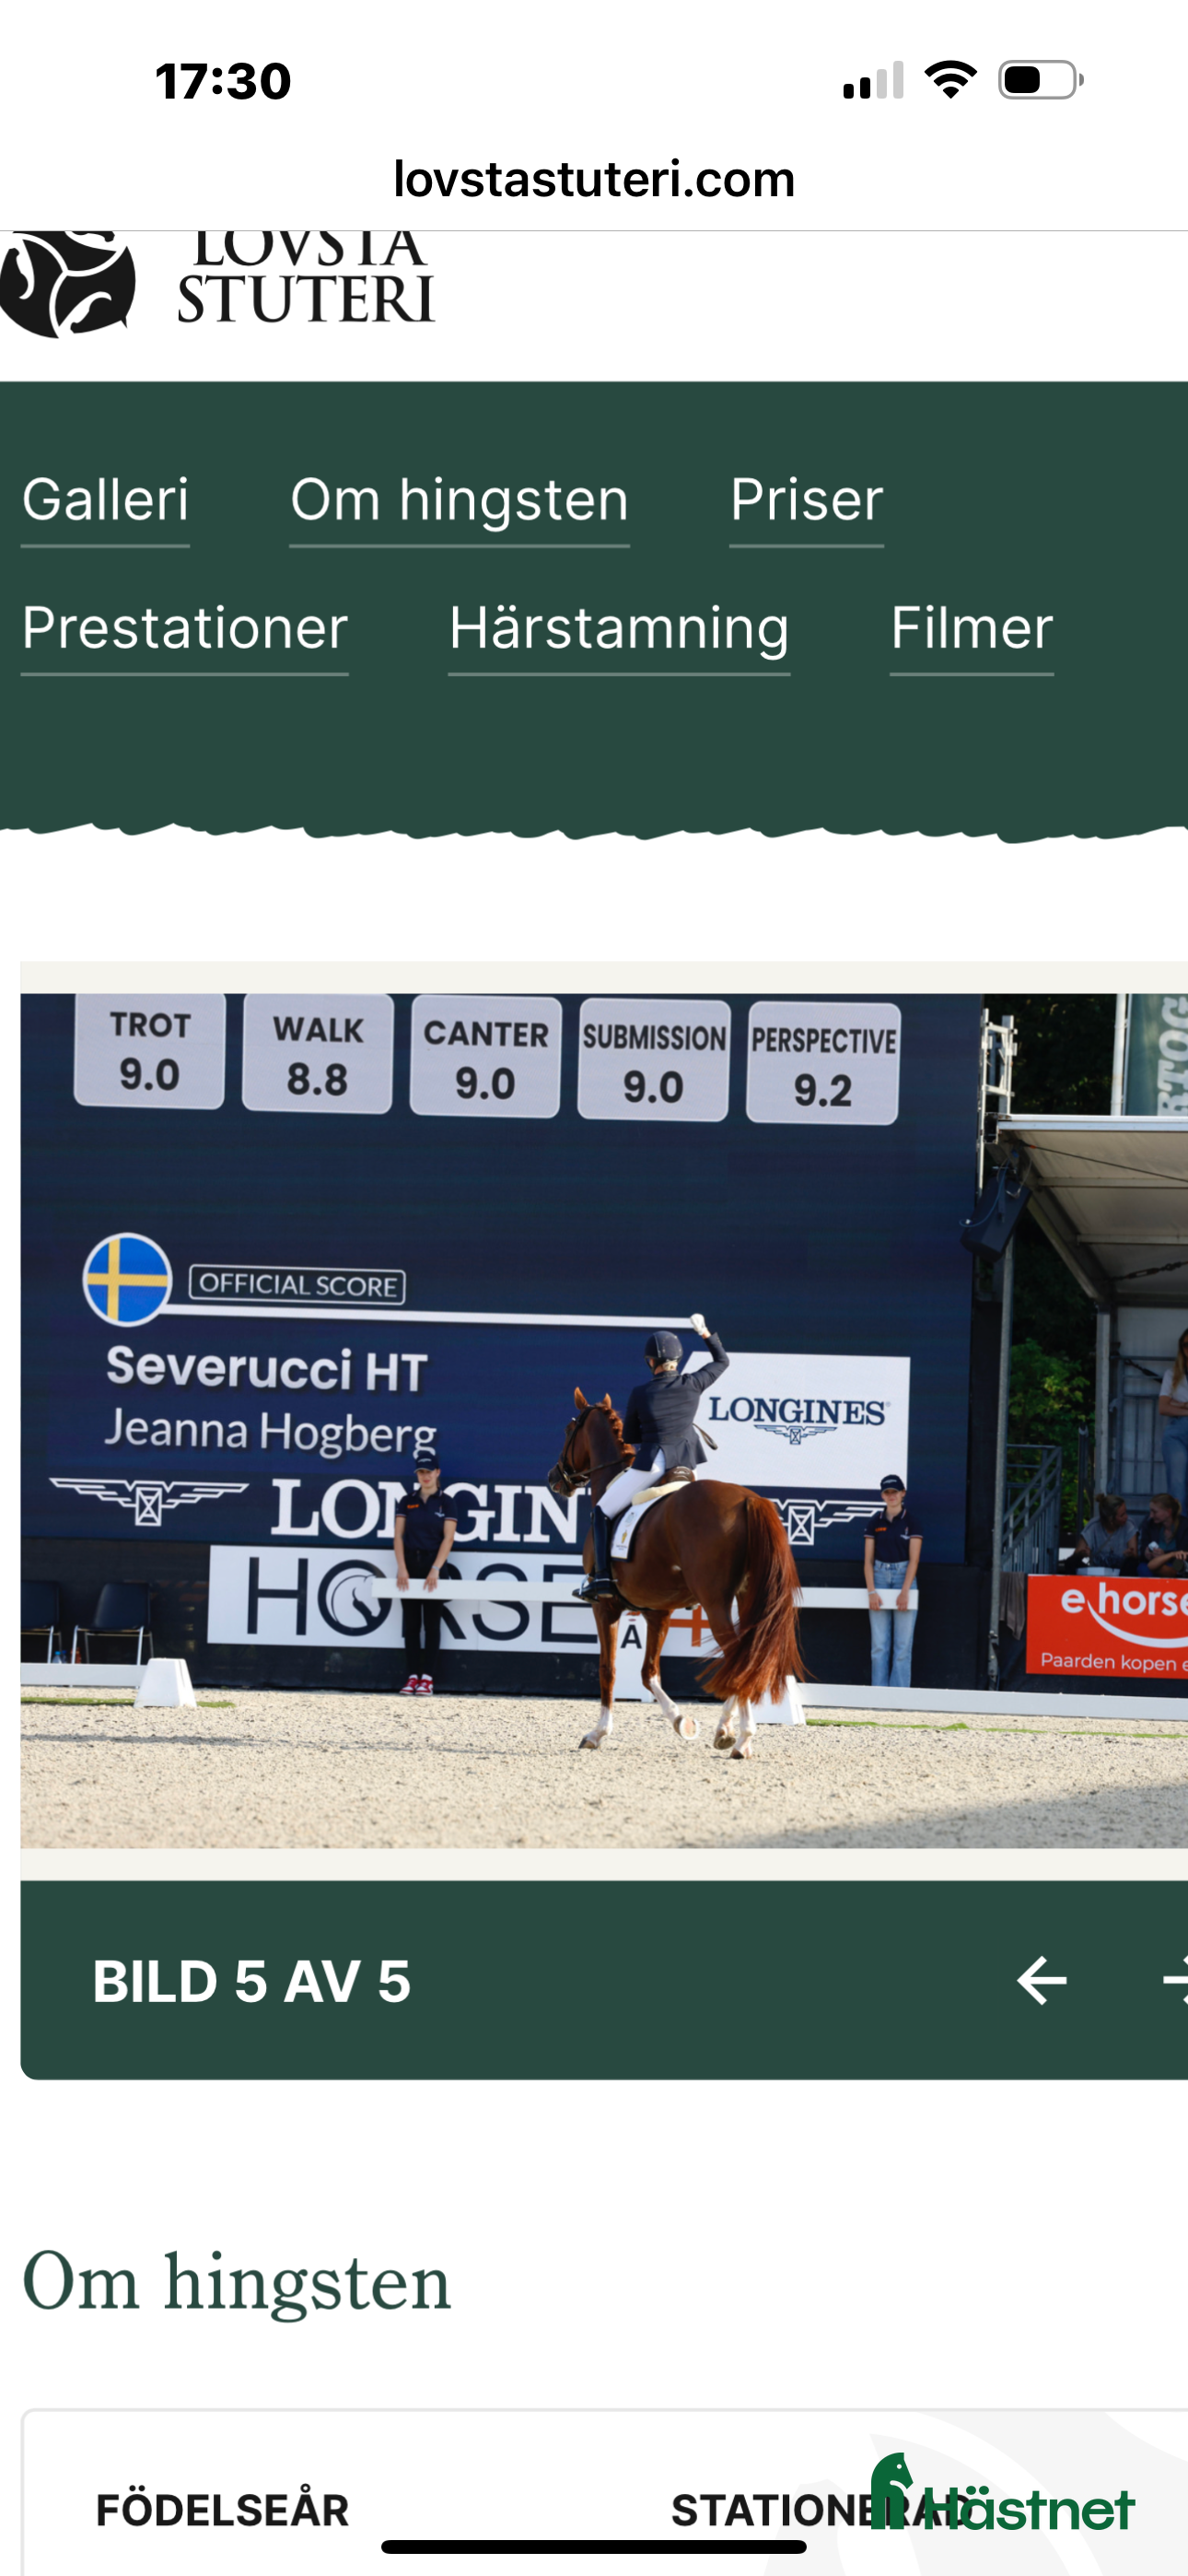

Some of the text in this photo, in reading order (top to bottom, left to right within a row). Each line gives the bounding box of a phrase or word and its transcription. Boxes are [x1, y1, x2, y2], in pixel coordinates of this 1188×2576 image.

[157, 63, 290, 100] 17:30
[396, 158, 793, 197] lovstastuteri.com
[178, 275, 436, 322] STUTERI
[23, 476, 188, 521] Galleri
[291, 476, 627, 532] Om hingsten
[733, 476, 884, 521] Priser
[25, 605, 349, 650] Prestationer
[452, 605, 787, 661] Härstamning
[893, 605, 1054, 650] Filmer
[110, 1012, 192, 1038] TROT
[273, 1015, 364, 1044] WALK
[424, 1020, 549, 1048] CANTER
[583, 1024, 727, 1051] SUBMISSION
[751, 1026, 897, 1054] PERSPECTIVE
[120, 1058, 180, 1092] 9.0
[286, 1062, 348, 1096] 8.8
[456, 1067, 516, 1100] 9.0
[623, 1071, 683, 1104] 9.0
[794, 1073, 852, 1107] 9.2
[199, 1272, 398, 1299] OFFICIAL SCORE
[107, 1345, 428, 1392] Severucci HT
[708, 1397, 886, 1426] LONGINES
[104, 1407, 437, 1460] Jeanna Hogberg
[620, 1624, 642, 1649] A
[1041, 1652, 1115, 1669] Paarden
[1121, 1655, 1177, 1673] kopen
[94, 1961, 411, 2003] BILD 5 AV 5
[23, 2250, 452, 2324] Om hingsten
[97, 2484, 349, 2527] FÖDELSEÅR
